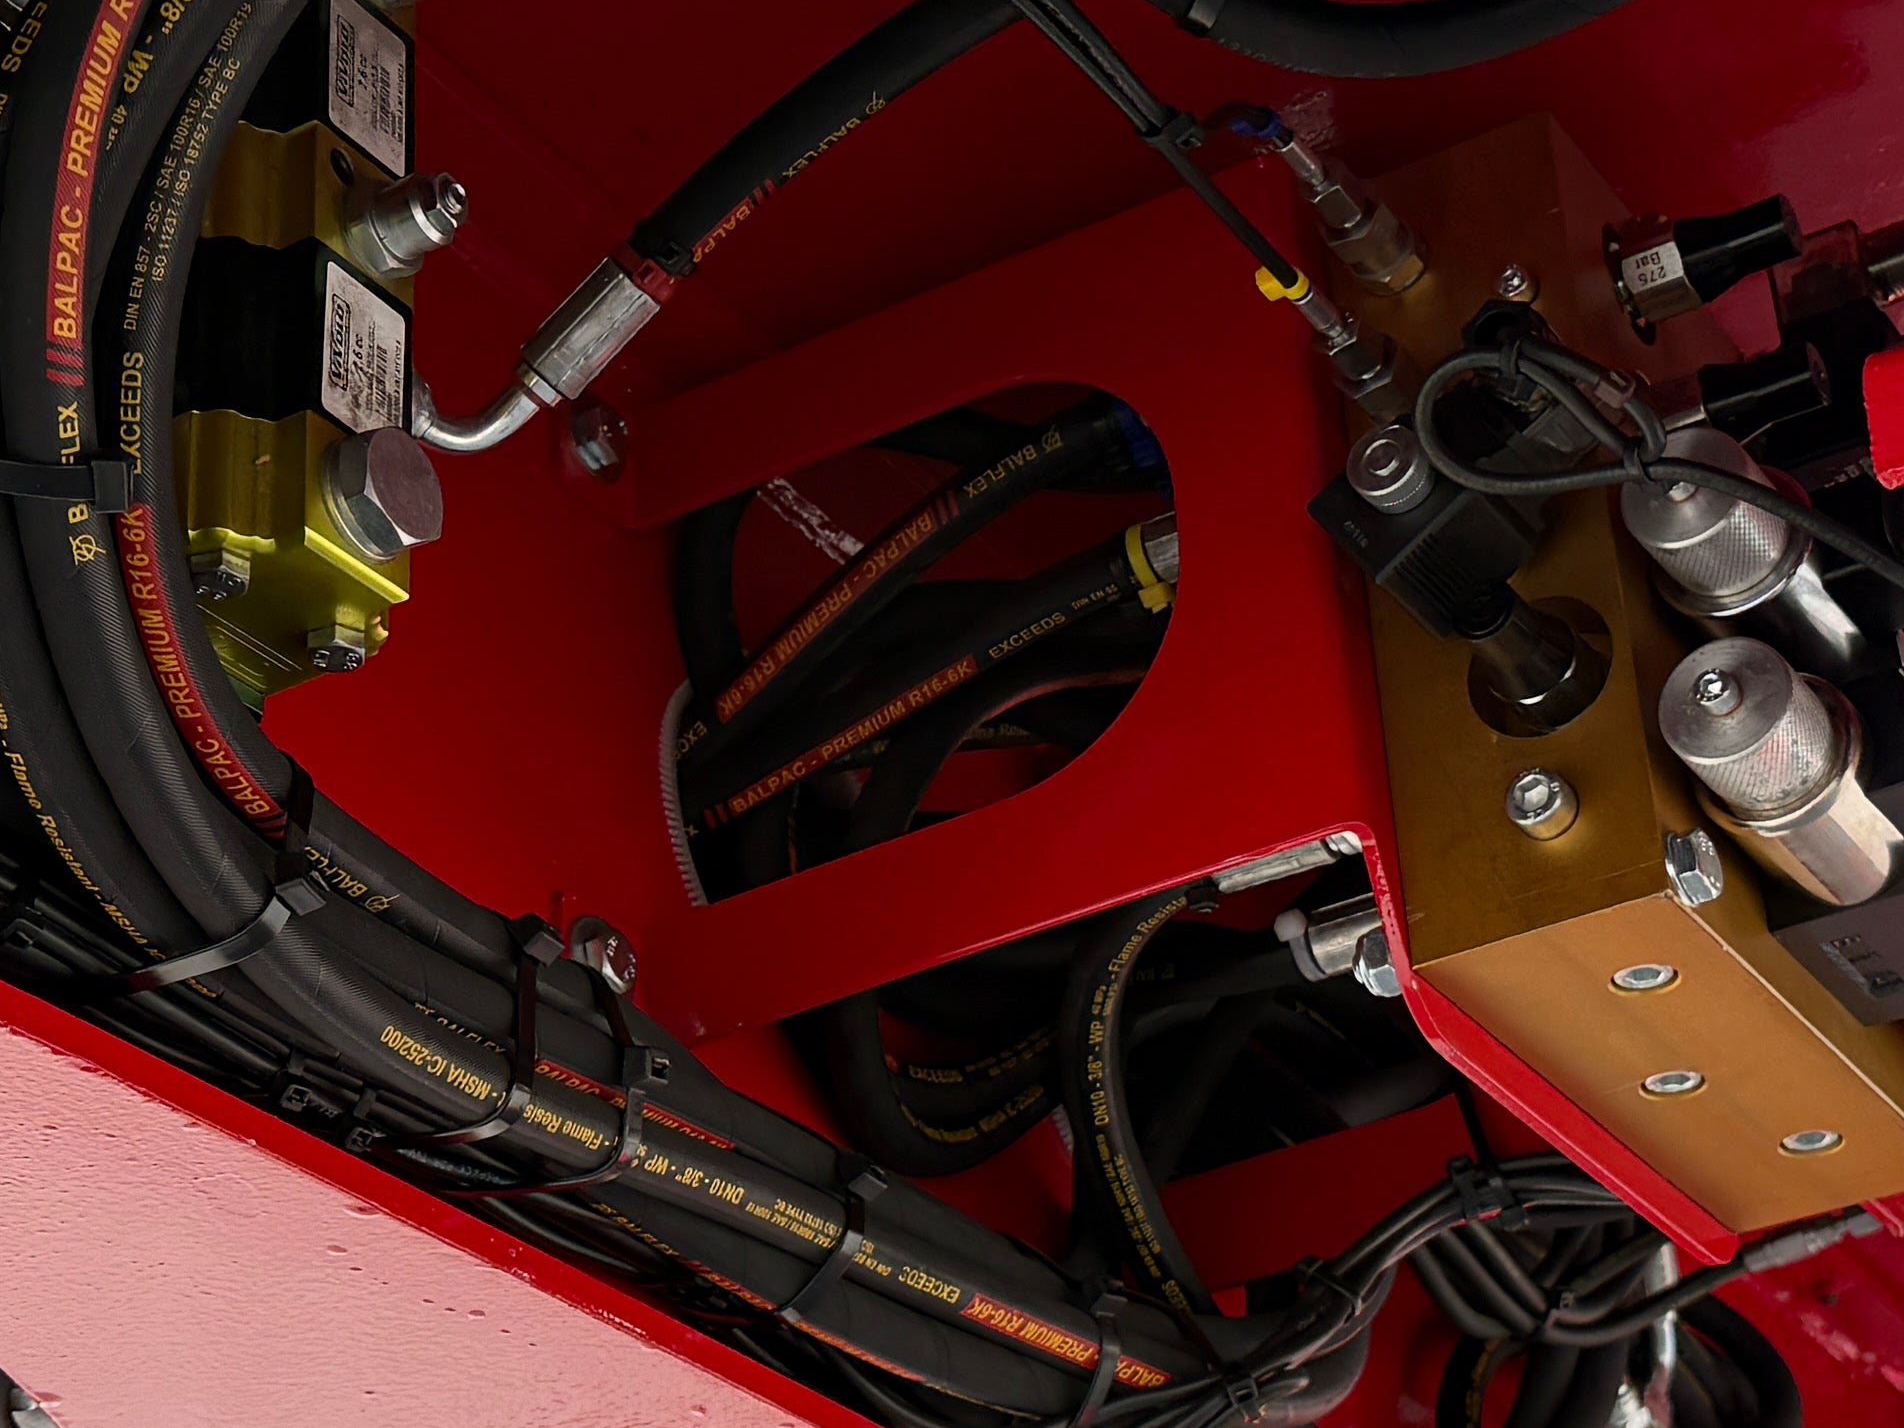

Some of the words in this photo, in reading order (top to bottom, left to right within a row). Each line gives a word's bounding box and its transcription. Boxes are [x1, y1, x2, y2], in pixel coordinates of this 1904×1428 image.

[123, 50, 154, 94] WP
[199, 55, 222, 88] SAE
[66, 20, 122, 179] PREMIUM
[169, 98, 201, 152] 100R16
[152, 254, 166, 283] ISO
[202, 82, 230, 121] TYPE
[156, 153, 177, 189] SAE
[53, 204, 85, 339] BALPAC
[137, 244, 149, 273] 857
[1634, 251, 1661, 269] Bar
[129, 278, 143, 301] EN
[124, 306, 137, 332] DIN
[963, 443, 1037, 499] BALFLEX
[121, 506, 157, 600] R16-6K
[868, 510, 935, 570] BALPAC
[775, 583, 852, 661] PREMIUM
[136, 608, 201, 720] PREMIUM
[729, 760, 805, 814] BALPAC
[822, 701, 906, 761] PREMIUM
[988, 611, 1067, 659] EXCEEDS
[195, 737, 270, 817] BALPAC
[1107, 933, 1142, 975] Flame
[380, 1024, 448, 1080] IC-252/00
[446, 1067, 492, 1104] MSHA
[561, 1119, 604, 1149] Flame
[642, 1150, 670, 1177] WP
[709, 1178, 745, 1206] DN10
[969, 1297, 1024, 1332] R16-6K
[1019, 1320, 1093, 1362] PREMIUM
